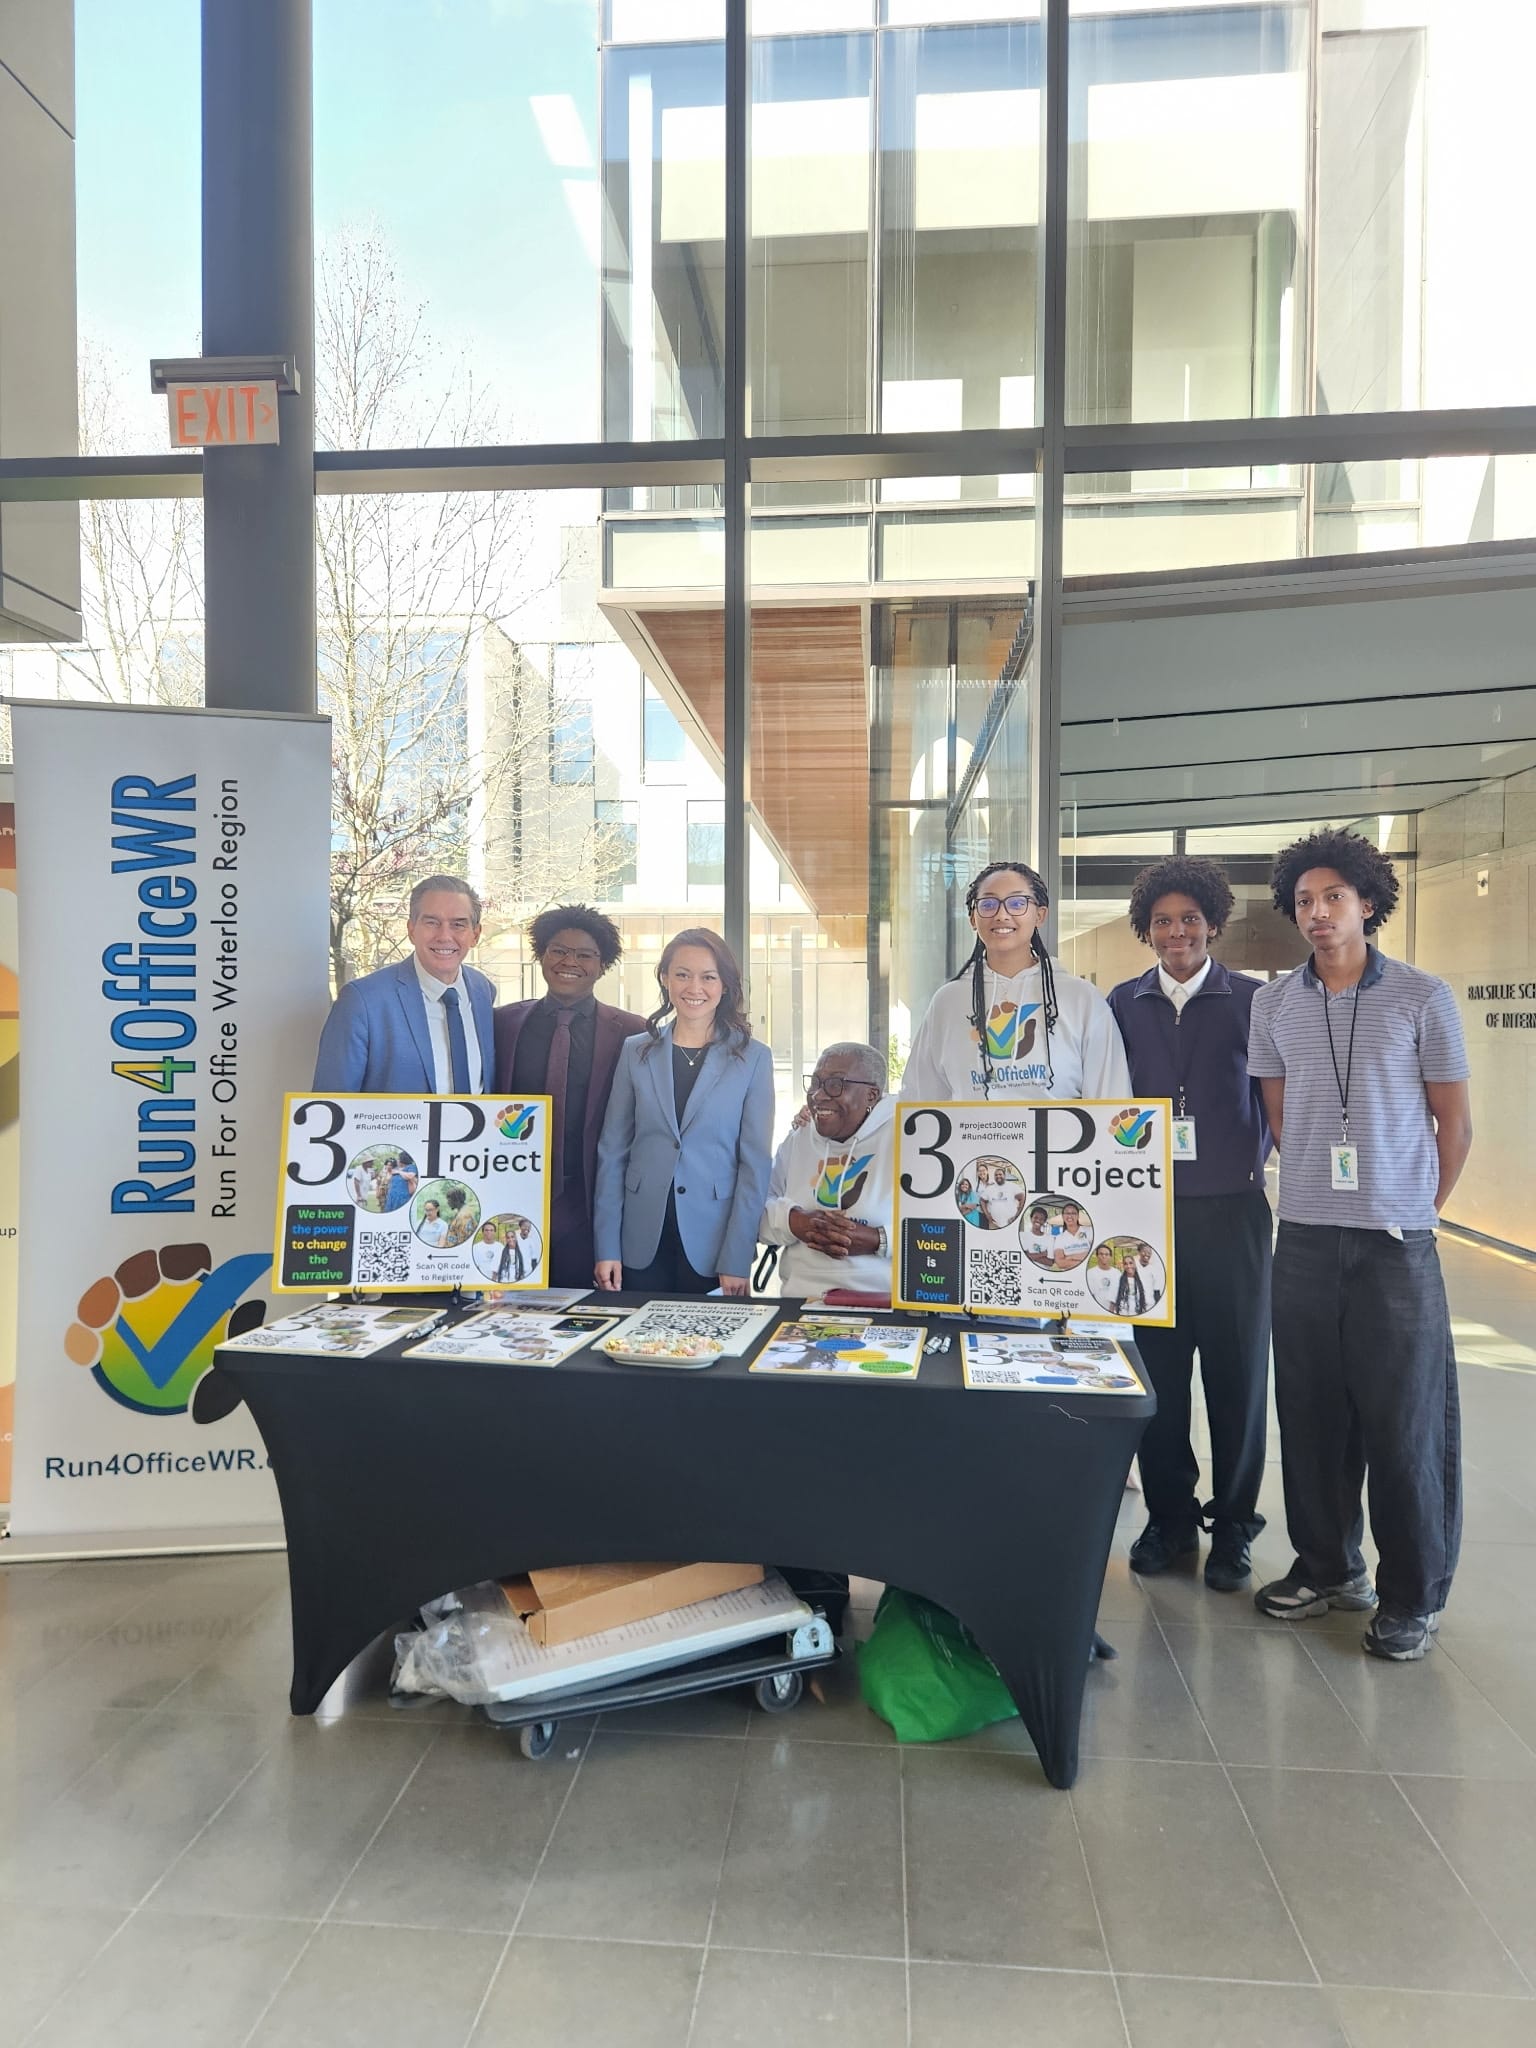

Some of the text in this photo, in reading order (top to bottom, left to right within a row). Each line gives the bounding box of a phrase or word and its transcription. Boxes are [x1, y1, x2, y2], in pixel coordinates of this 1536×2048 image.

[176, 387, 260, 444] EXIT
[102, 773, 198, 1215] Run4OfficeWR
[210, 778, 246, 1217] Run For Office Waterloo Region
[1468, 984, 1516, 1000] BALSILLIE
[1486, 1012, 1500, 1028] OF
[353, 1112, 422, 1122] #Project3000WR
[355, 1123, 419, 1132] #Run4OfficeWR
[959, 1121, 1027, 1131] #project3000WR
[961, 1132, 1025, 1142] #Run4OfficeWR
[287, 1100, 347, 1186] 3
[900, 1109, 955, 1199] 3
[298, 1209, 345, 1219] We have
[291, 1224, 348, 1237] the power
[920, 1223, 946, 1234] Your
[291, 1239, 347, 1252] to change
[916, 1240, 947, 1251] Voice
[308, 1254, 328, 1265] the
[926, 1256, 936, 1267] is
[416, 1262, 470, 1271] Scan QR code
[291, 1269, 343, 1280] narrative
[431, 1273, 464, 1283] Register
[919, 1273, 945, 1284] Your
[915, 1289, 949, 1301] Power
[1027, 1286, 1085, 1297] Scan QR code
[1033, 1299, 1079, 1311] to Register
